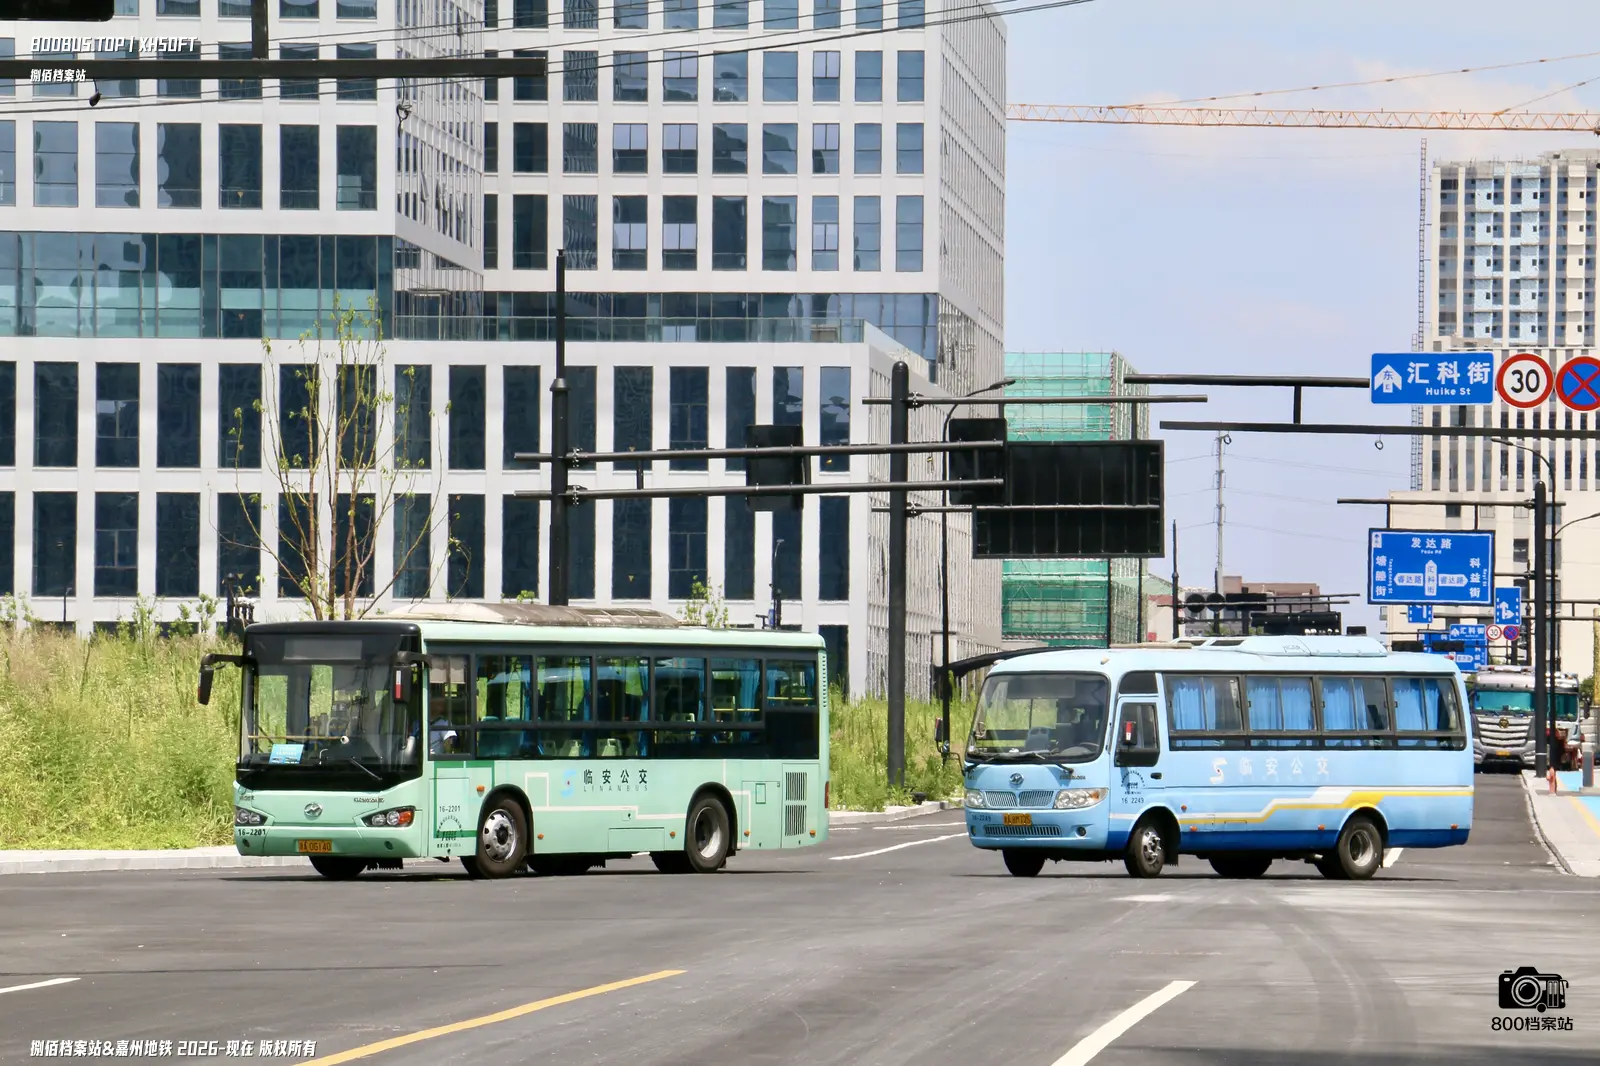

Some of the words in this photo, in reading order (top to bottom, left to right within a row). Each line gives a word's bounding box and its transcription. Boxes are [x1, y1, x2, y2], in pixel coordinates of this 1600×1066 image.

[1407, 361, 1491, 385] 汇科街
[1511, 369, 1541, 393] 30
[1425, 387, 1456, 396] Huike
[1459, 387, 1471, 396] St
[1411, 537, 1452, 549] 发达路
[1489, 628, 1499, 637] 30
[1239, 757, 1329, 775] 临安公交
[583, 769, 647, 784] 临安公交
